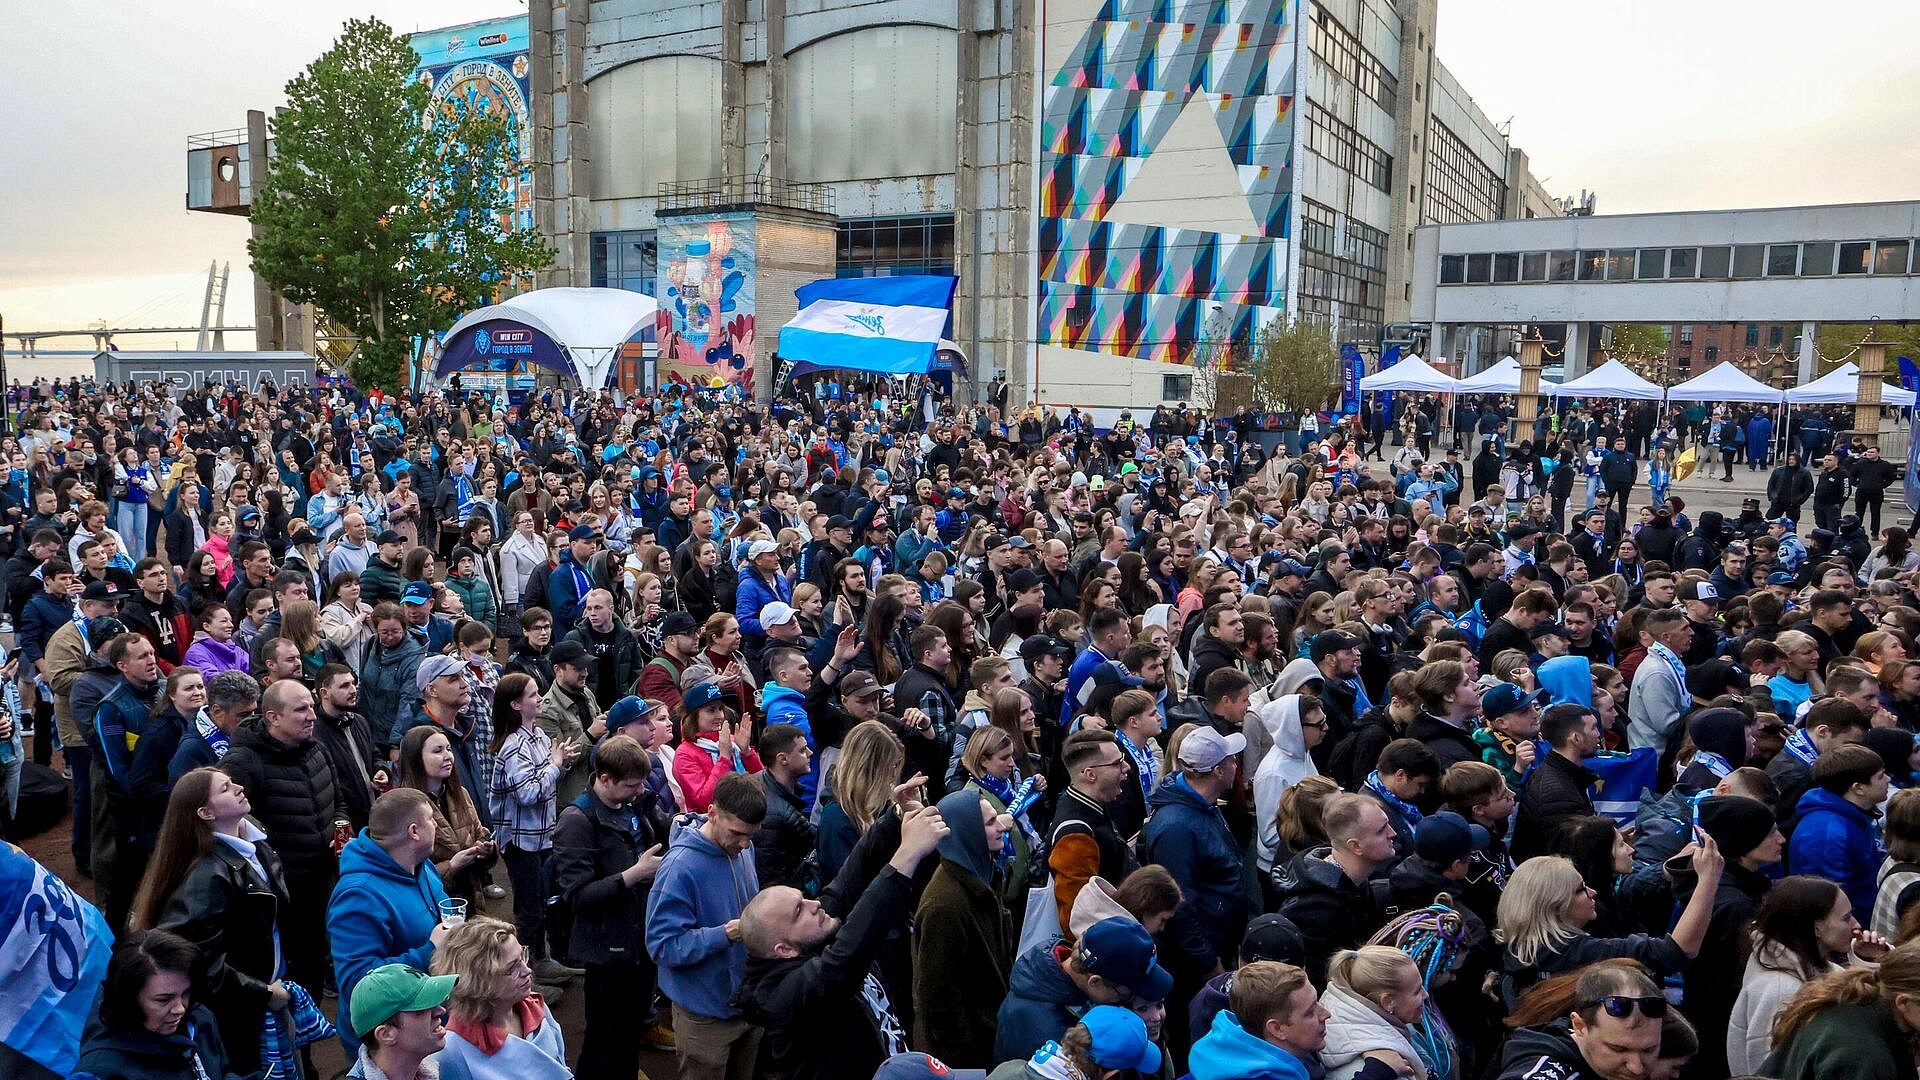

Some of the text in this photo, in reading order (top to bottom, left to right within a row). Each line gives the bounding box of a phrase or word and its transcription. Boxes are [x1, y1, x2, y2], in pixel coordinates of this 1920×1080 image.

[439, 73, 455, 96] CITY
[462, 63, 487, 77] ГОРОД
[488, 66, 496, 77] В
[495, 70, 522, 107] ЗЕНИТЕ
[500, 333, 524, 341] WIN CITY
[492, 345, 533, 355] ГОРОД В ЗЕНИТЕ
